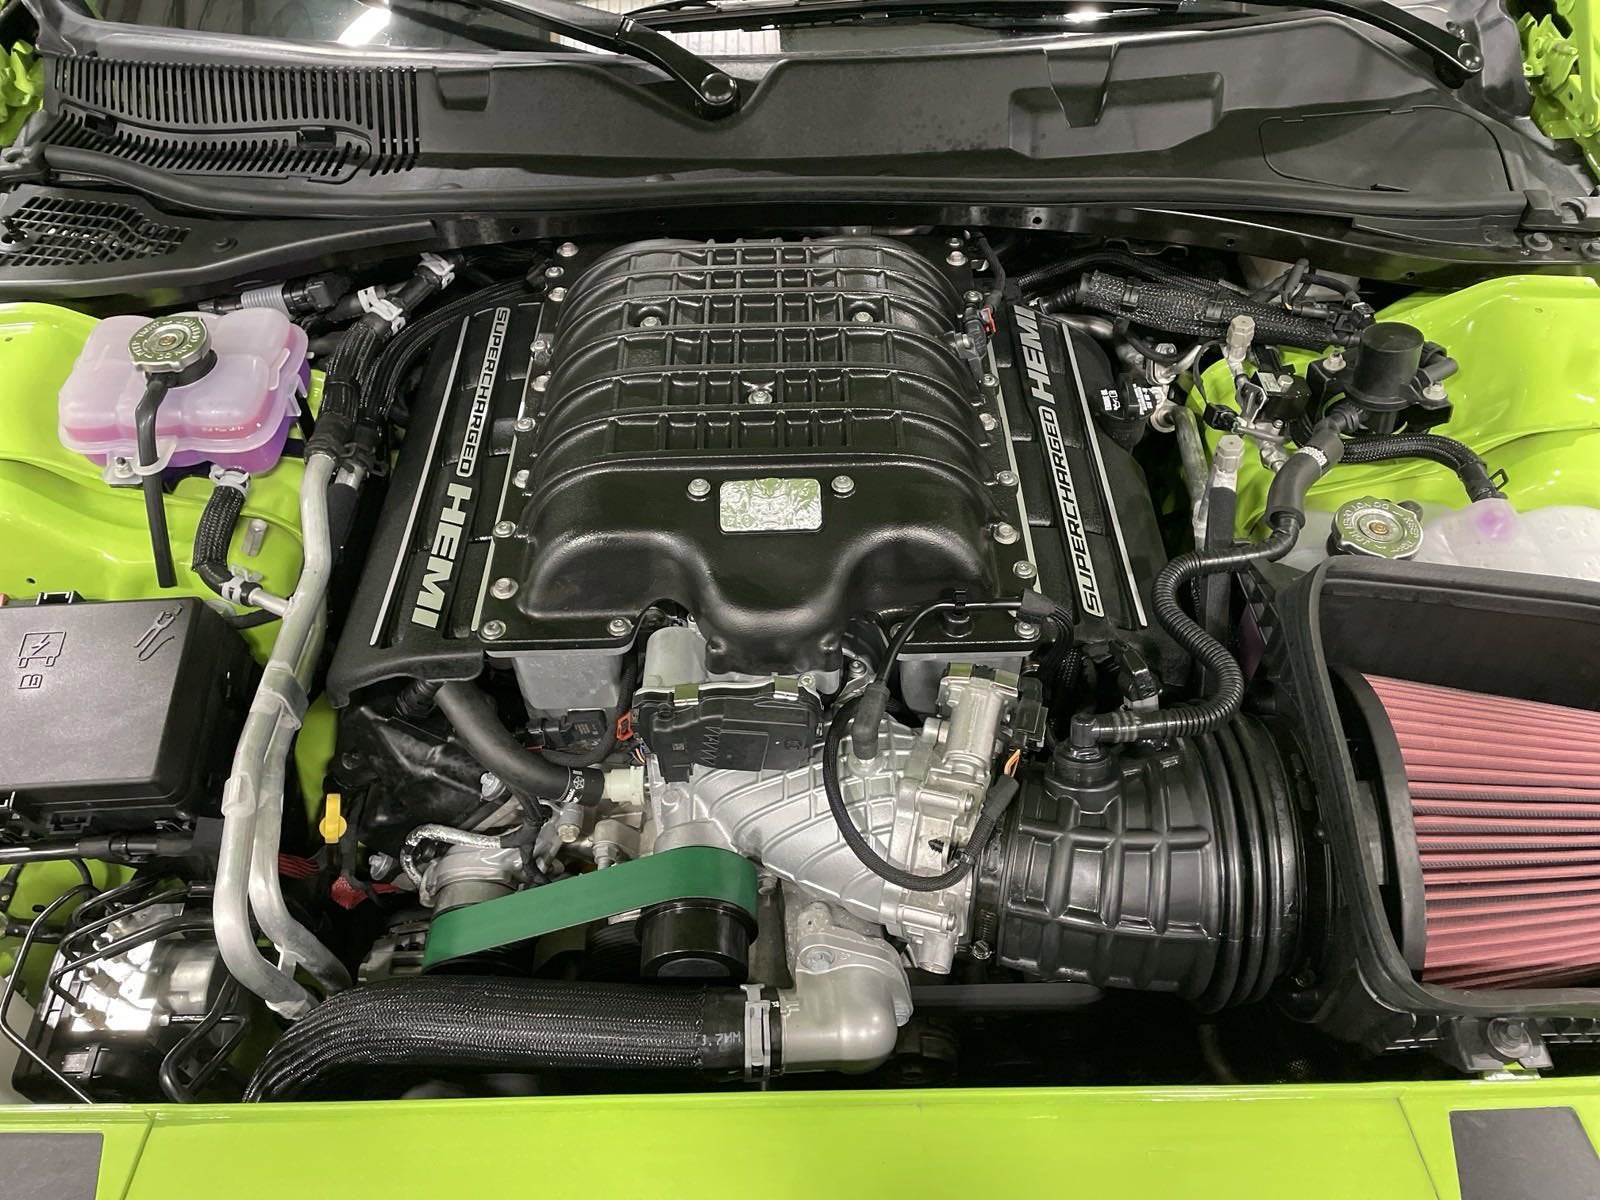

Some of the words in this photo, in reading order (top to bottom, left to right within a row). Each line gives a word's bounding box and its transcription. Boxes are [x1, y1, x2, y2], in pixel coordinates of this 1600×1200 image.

[458, 308, 509, 475] SUPERCHARGED
[1013, 304, 1056, 404] HEMI
[411, 483, 472, 629] HEMI
[1040, 407, 1103, 616] SUPERCHARGED
